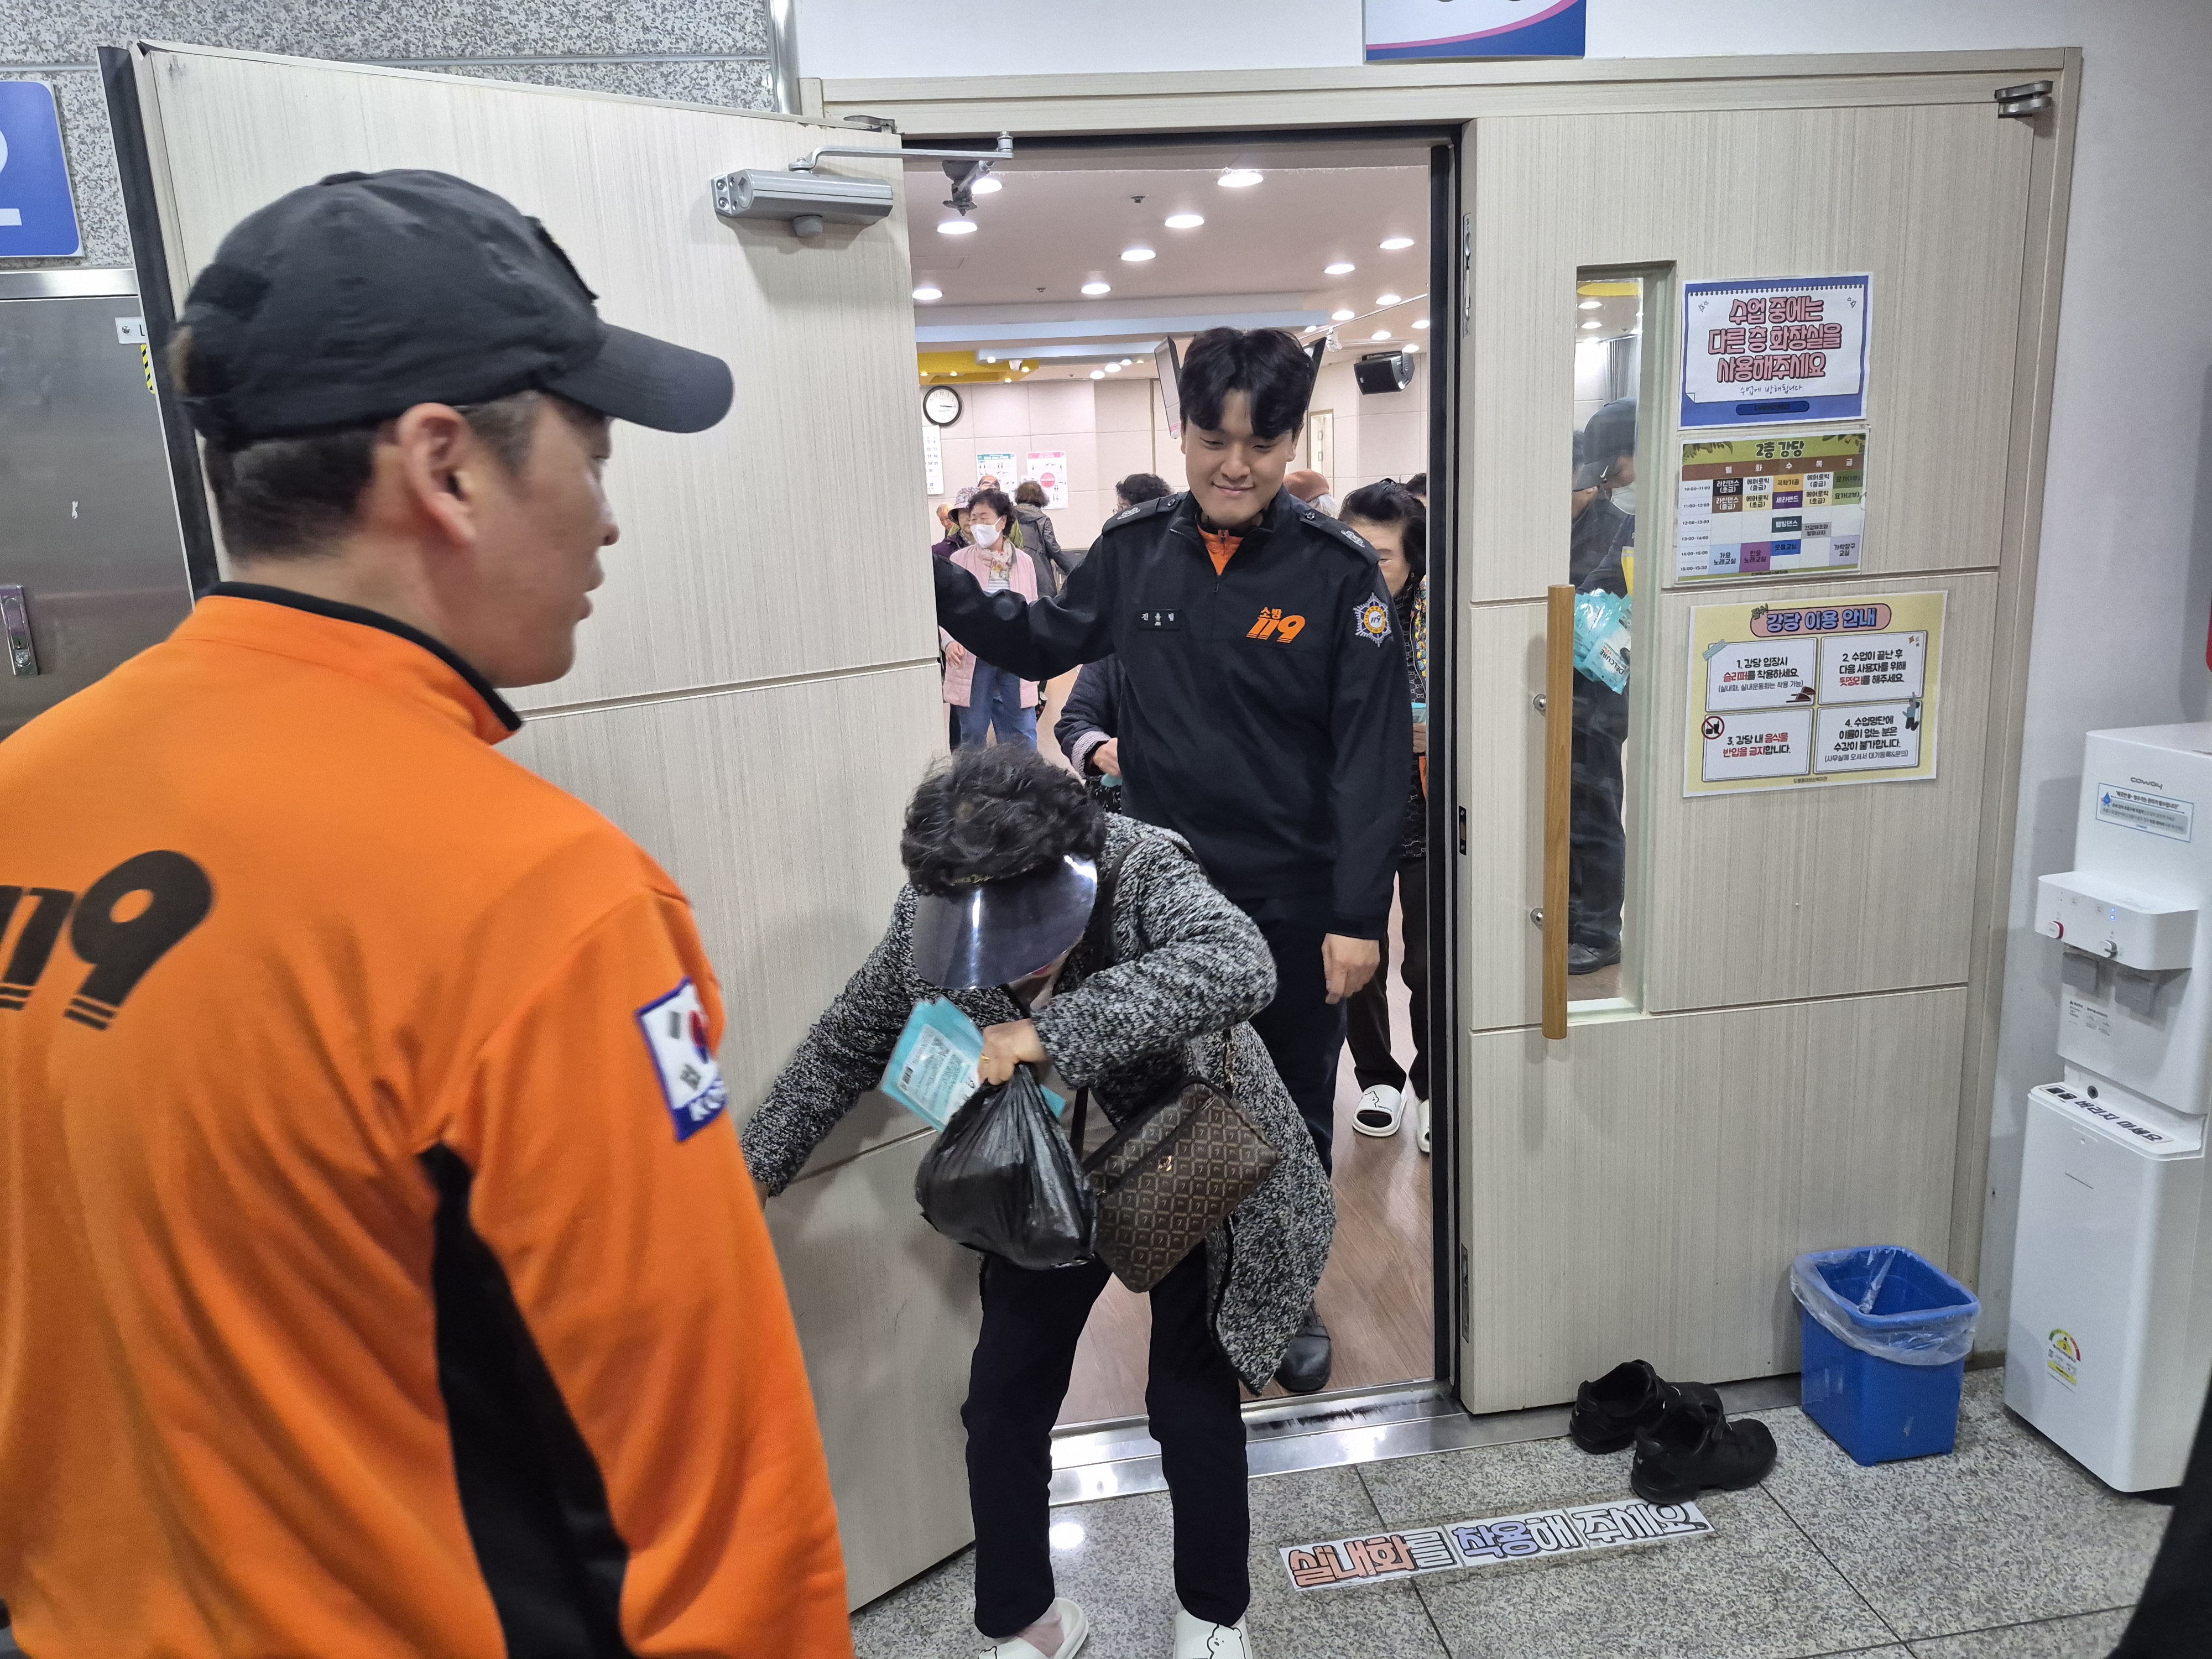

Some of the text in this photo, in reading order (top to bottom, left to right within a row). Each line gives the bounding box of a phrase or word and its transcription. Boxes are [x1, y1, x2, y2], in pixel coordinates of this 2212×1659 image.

[1729, 295, 1824, 325] 수업 중에는
[1708, 323, 1842, 354] 다른 층 화장실을
[1717, 352, 1827, 383] 사용해주세요
[1740, 385, 1761, 396] 수업에
[1755, 440, 1804, 459] 2층 강당
[1716, 479, 1740, 488] 라인댄스
[1834, 492, 1860, 500] 요가(2부)
[1259, 607, 1282, 619] 소방
[1370, 615, 1381, 624] 119
[1766, 607, 1877, 633] 강당 이용 안내
[1246, 615, 1306, 644] 119
[1599, 649, 1624, 675] DELCURE
[1842, 649, 1903, 662] 2. 수업이 끝난 후
[1736, 656, 1788, 669] 1. 강당 입장시
[1839, 661, 1907, 674] 다음 사용자를 위해
[1723, 670, 1756, 682] 슬리퍼를
[1839, 675, 1870, 686] 뒷정리를
[1741, 682, 1775, 691] 실내운동화는
[1845, 715, 1894, 728] 4. 수업명단에
[1727, 732, 1788, 745] 3. 강당 내 음식물
[1839, 727, 1898, 739] 이름이 없는 분은
[1723, 744, 1791, 758] 반입을 금지합니다.
[1833, 738, 1901, 752] 수강이 불가합니다.
[1824, 754, 1849, 763] (사무실에
[1869, 749, 1908, 759] 대기등록&문의)
[2074, 1100, 2120, 1120] 버리지
[2116, 1120, 2163, 1142] 마세요
[1288, 1531, 1457, 1588] 실내화를
[1451, 1514, 1583, 1559] 착용해
